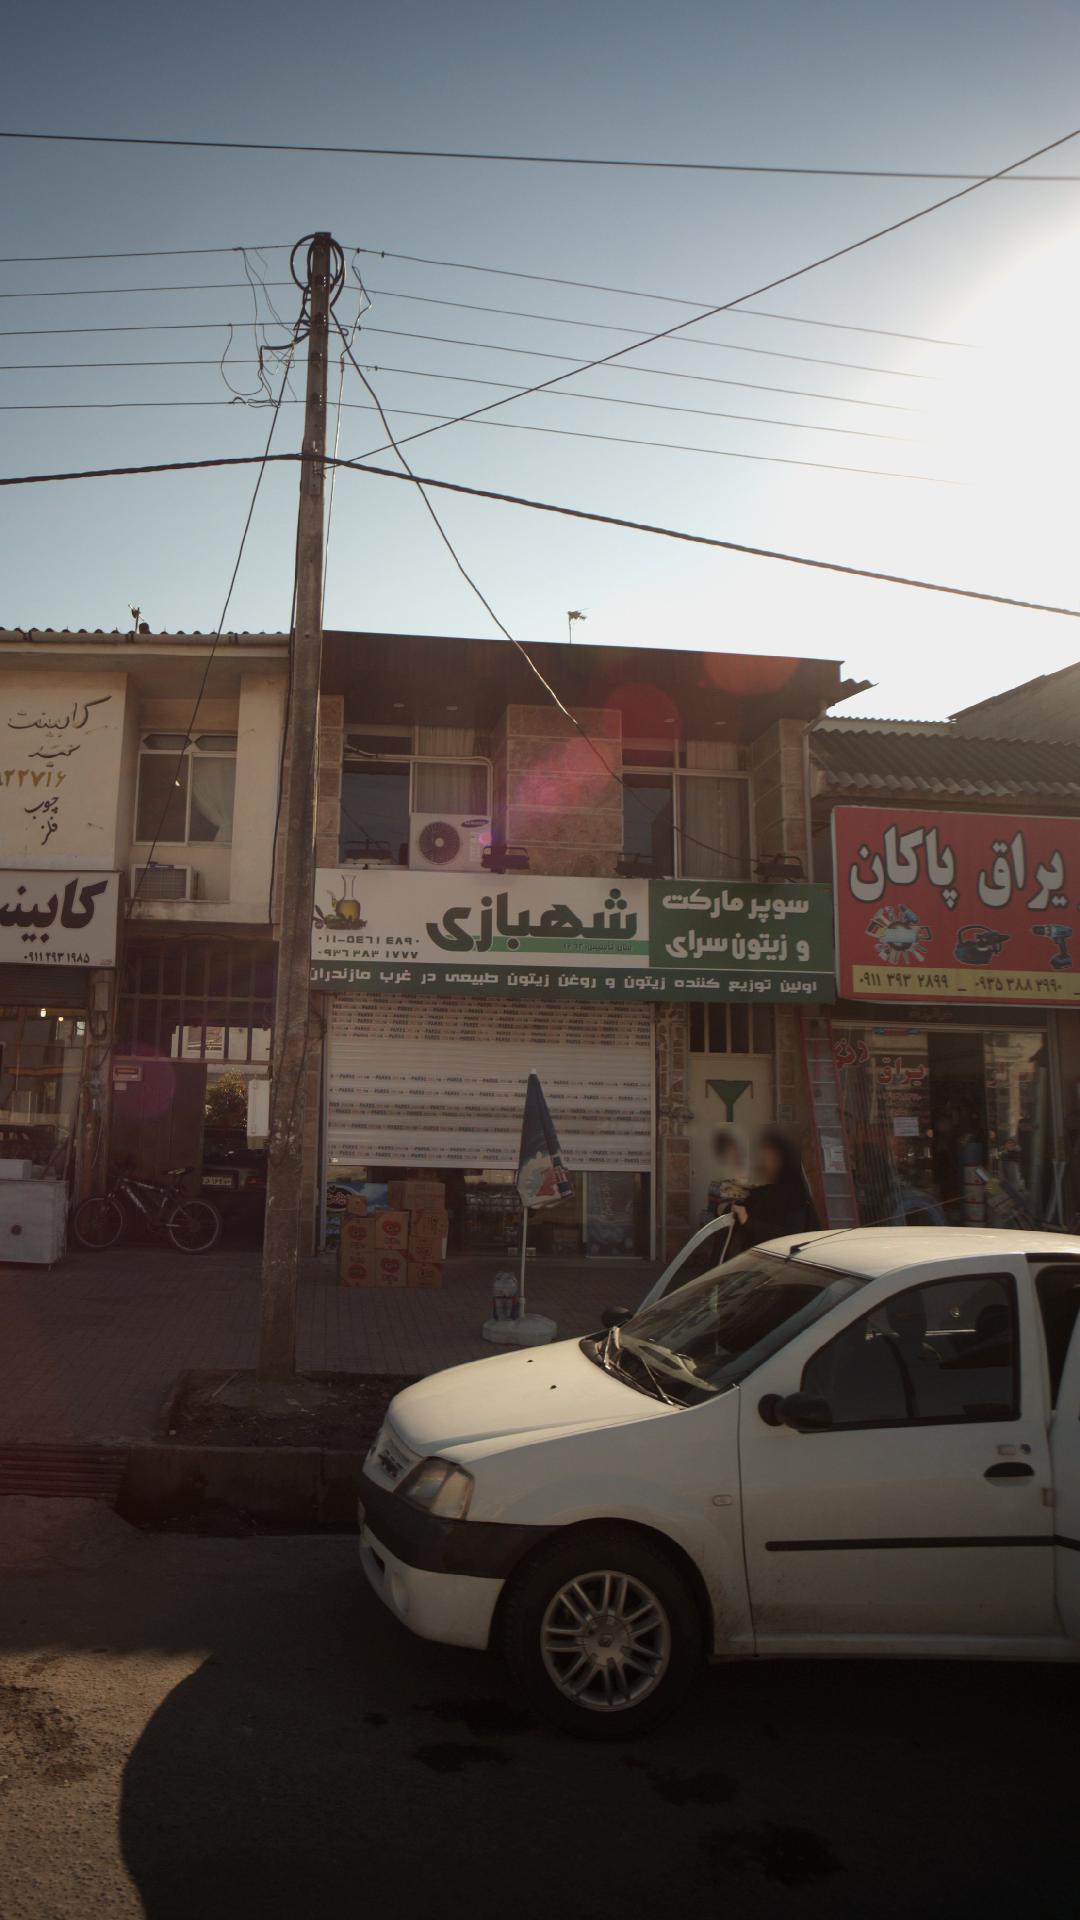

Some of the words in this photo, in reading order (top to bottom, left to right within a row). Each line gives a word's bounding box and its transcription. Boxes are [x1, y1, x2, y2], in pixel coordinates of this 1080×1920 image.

[8, 695, 112, 738] کابینت
[24, 797, 60, 820] چوب
[39, 816, 59, 846] فلز
[849, 822, 959, 911] پاکان
[978, 830, 1068, 911] یراق
[663, 889, 743, 918] مارکت
[0, 878, 108, 944] کابین
[748, 899, 808, 923] سوپر
[424, 888, 638, 953] شهبازی
[665, 930, 727, 958] سرای
[796, 941, 809, 961] و
[67, 953, 89, 963] ۱۹۸۵
[380, 970, 411, 983] غرب
[421, 974, 436, 984] در
[445, 973, 498, 985] طبیعی
[508, 973, 549, 987] زیتون
[558, 974, 596, 988] روغن
[606, 978, 615, 988] و
[624, 976, 665, 990] زیتون
[675, 978, 719, 988] کننده
[860, 972, 880, 986] ۰۹۱۱
[729, 980, 771, 992] توزیع
[781, 980, 816, 993] اولین
